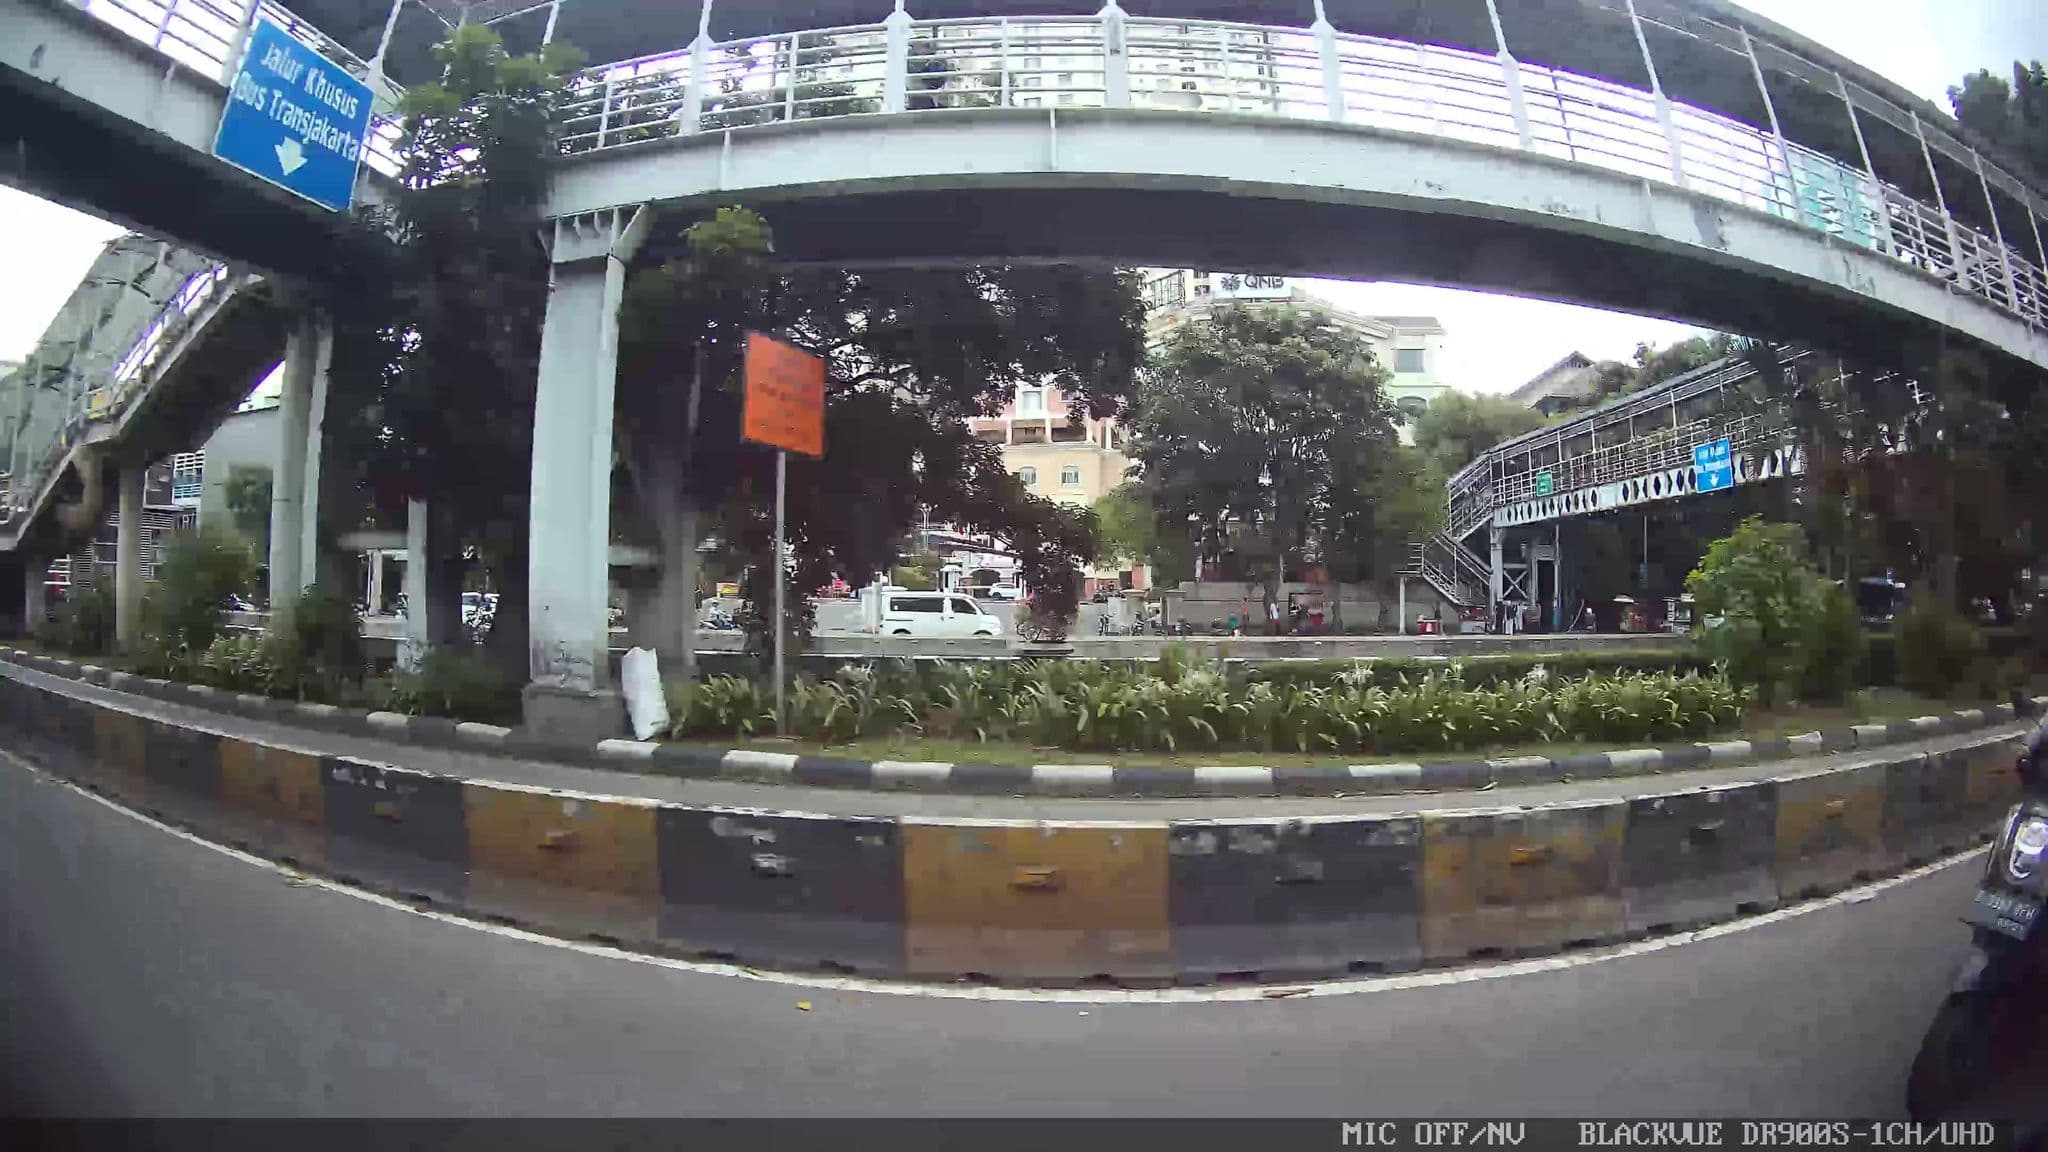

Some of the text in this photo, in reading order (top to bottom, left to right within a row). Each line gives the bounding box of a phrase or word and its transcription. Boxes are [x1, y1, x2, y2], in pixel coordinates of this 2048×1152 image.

[261, 42, 359, 119] Jalur Khusus
[268, 89, 360, 162] Transjakarta
[1244, 272, 1284, 289] QNB
